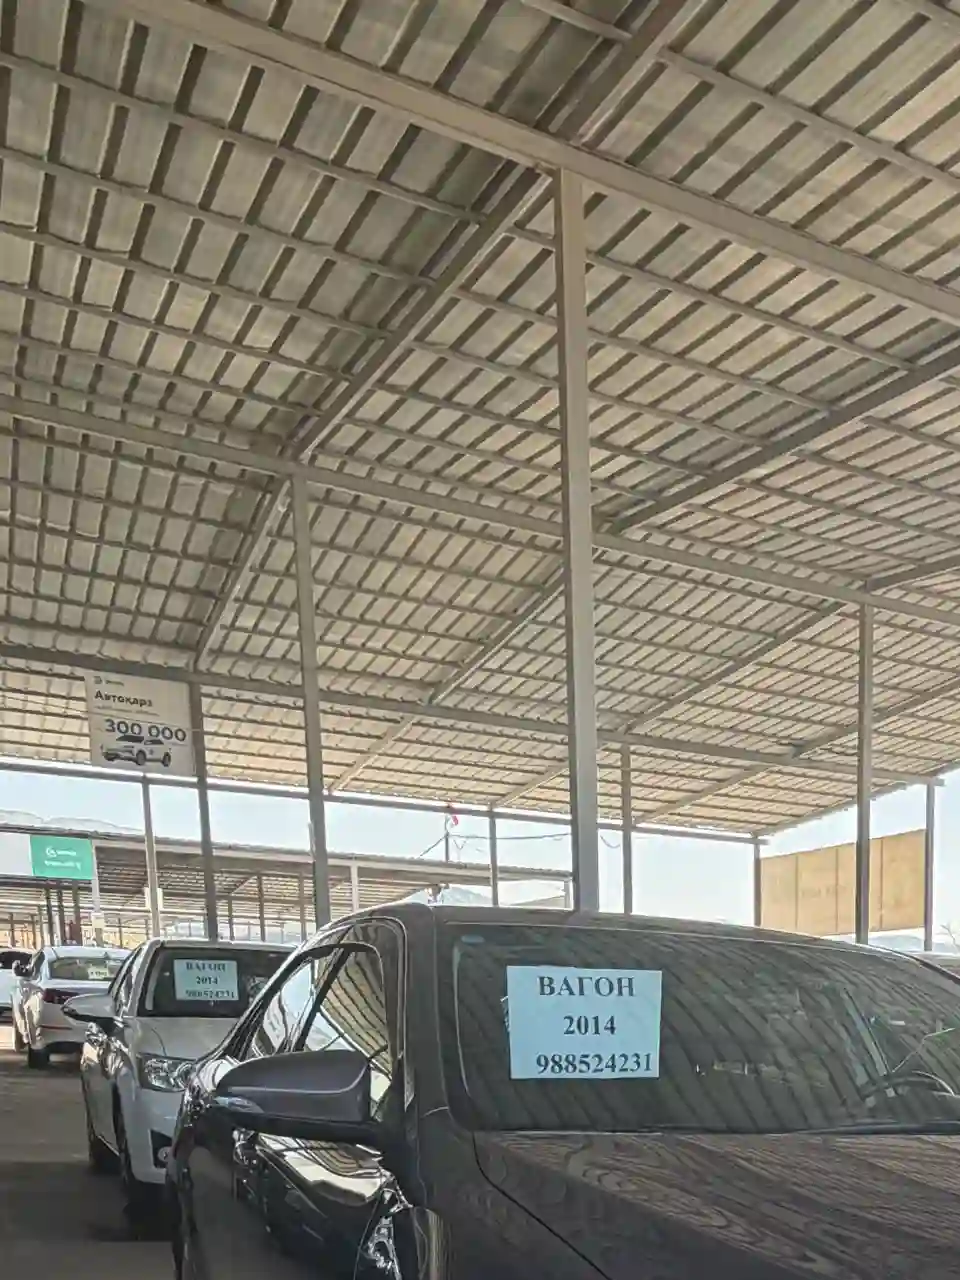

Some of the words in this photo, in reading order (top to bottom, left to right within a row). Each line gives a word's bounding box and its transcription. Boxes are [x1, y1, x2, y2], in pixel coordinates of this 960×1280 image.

[104, 718, 143, 736] 300
[148, 725, 187, 742] 000
[196, 976, 219, 985] 2014
[538, 976, 635, 997] ВАГОН
[563, 1015, 616, 1036] 2014
[536, 1053, 653, 1075] 988524231
